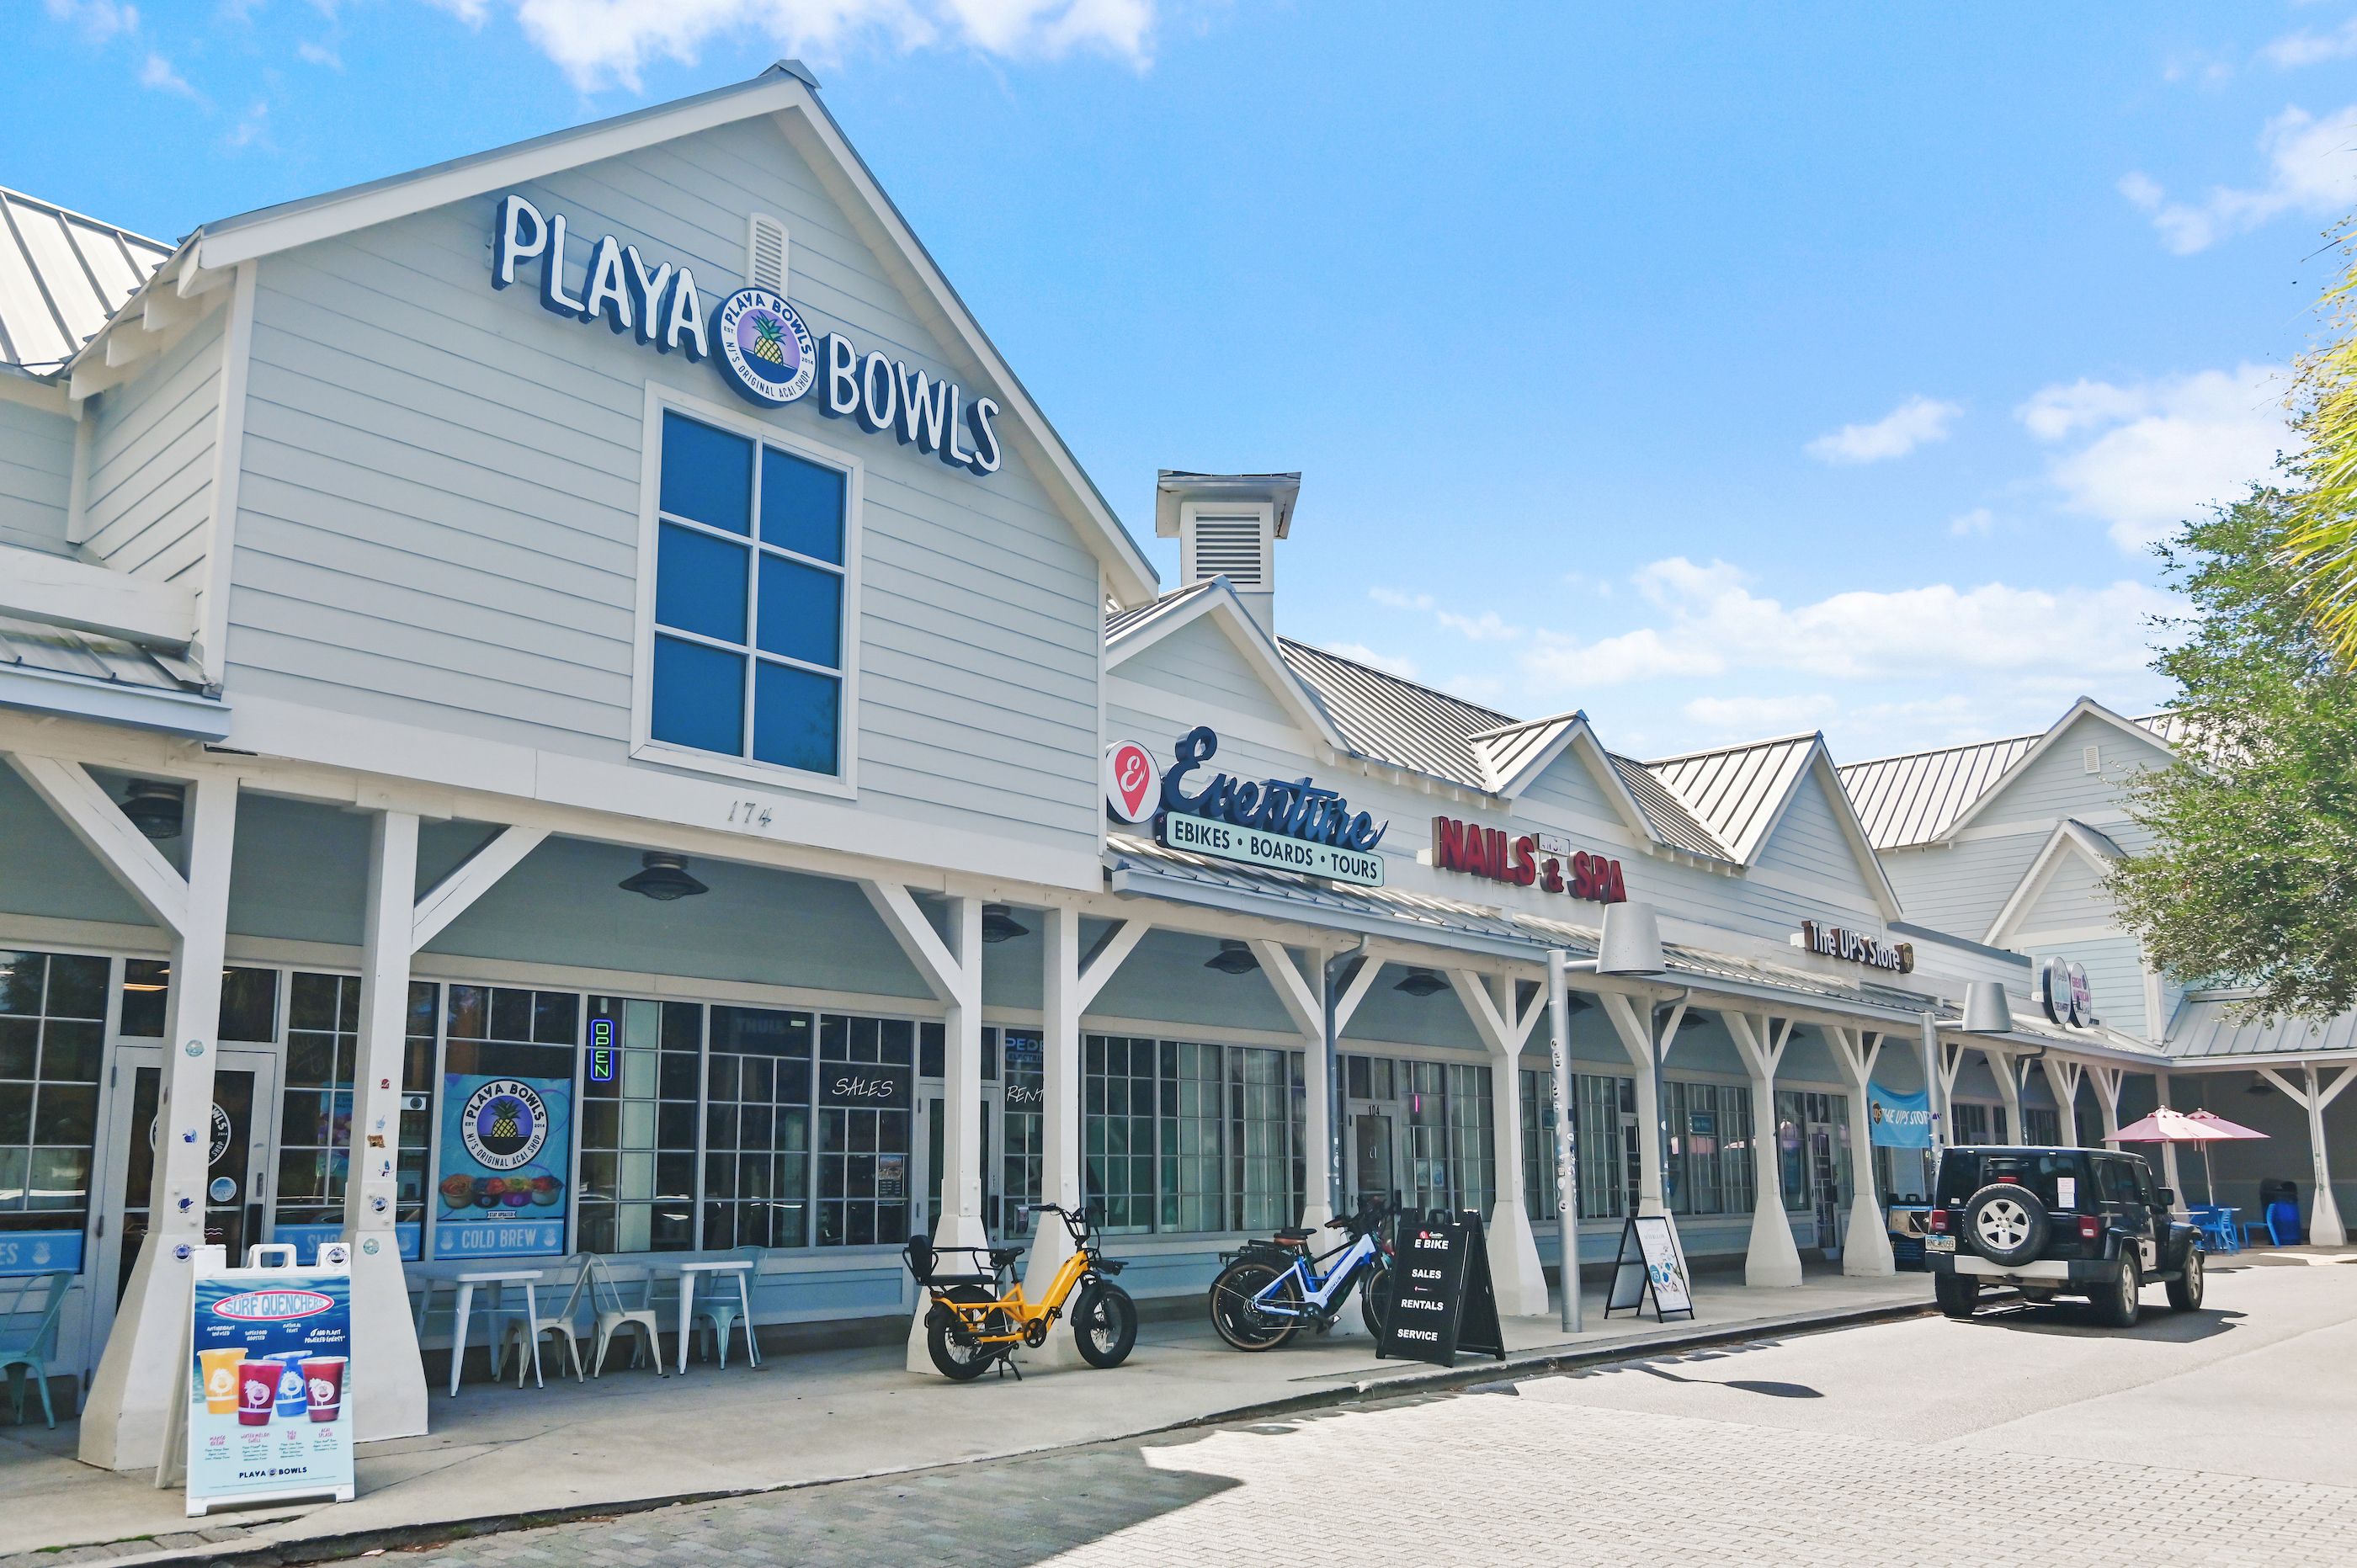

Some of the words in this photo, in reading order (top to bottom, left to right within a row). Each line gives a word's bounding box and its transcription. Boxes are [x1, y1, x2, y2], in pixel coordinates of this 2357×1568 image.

[497, 194, 708, 359] PLAYA
[823, 332, 1002, 474] BOWLS
[724, 292, 766, 327] PLAYA
[771, 299, 812, 355] BOWLS
[726, 342, 740, 363] NJ'S
[738, 365, 774, 397] ORIGINAL
[779, 385, 797, 398] ACAI
[795, 369, 811, 391] SHOP
[801, 357, 813, 365] 2014
[1162, 726, 1389, 853] Eventure
[727, 800, 773, 828] 174
[1174, 820, 1231, 849] EBIKES
[1251, 836, 1313, 866] BOARDS
[1331, 853, 1377, 880] TOURS
[1435, 816, 1536, 886] NAILS
[1540, 858, 1565, 893] &
[1569, 850, 1627, 903] SPA
[1808, 920, 1837, 956] The
[1838, 928, 1866, 962] UPS
[1868, 935, 1901, 970] Store
[594, 1023, 609, 1077] OPEN
[832, 1076, 894, 1098] SALES
[466, 1083, 504, 1119] PLAYA
[509, 1082, 545, 1121] BOWLS
[1369, 1104, 1380, 1117] 104
[1881, 1108, 1896, 1124] THE
[1895, 1110, 1911, 1124] UPS
[211, 1140, 225, 1156] SHOP
[466, 1133, 479, 1151] NJ'S
[476, 1149, 508, 1167] ORIGINAL
[512, 1151, 529, 1166] ACAI
[528, 1134, 541, 1153] SHOP
[462, 1229, 495, 1249] COLD
[500, 1228, 537, 1248] BREW
[1414, 1238, 1422, 1248] E
[1423, 1239, 1449, 1250] BIKE
[1411, 1268, 1442, 1279] SALES
[225, 1295, 257, 1316] SURF
[261, 1294, 325, 1316] QUENCHERS
[1401, 1299, 1444, 1311] RENTALS
[1397, 1328, 1439, 1342] SERVICE
[239, 1470, 267, 1479] PLAYA
[279, 1466, 307, 1475] BOWLS
